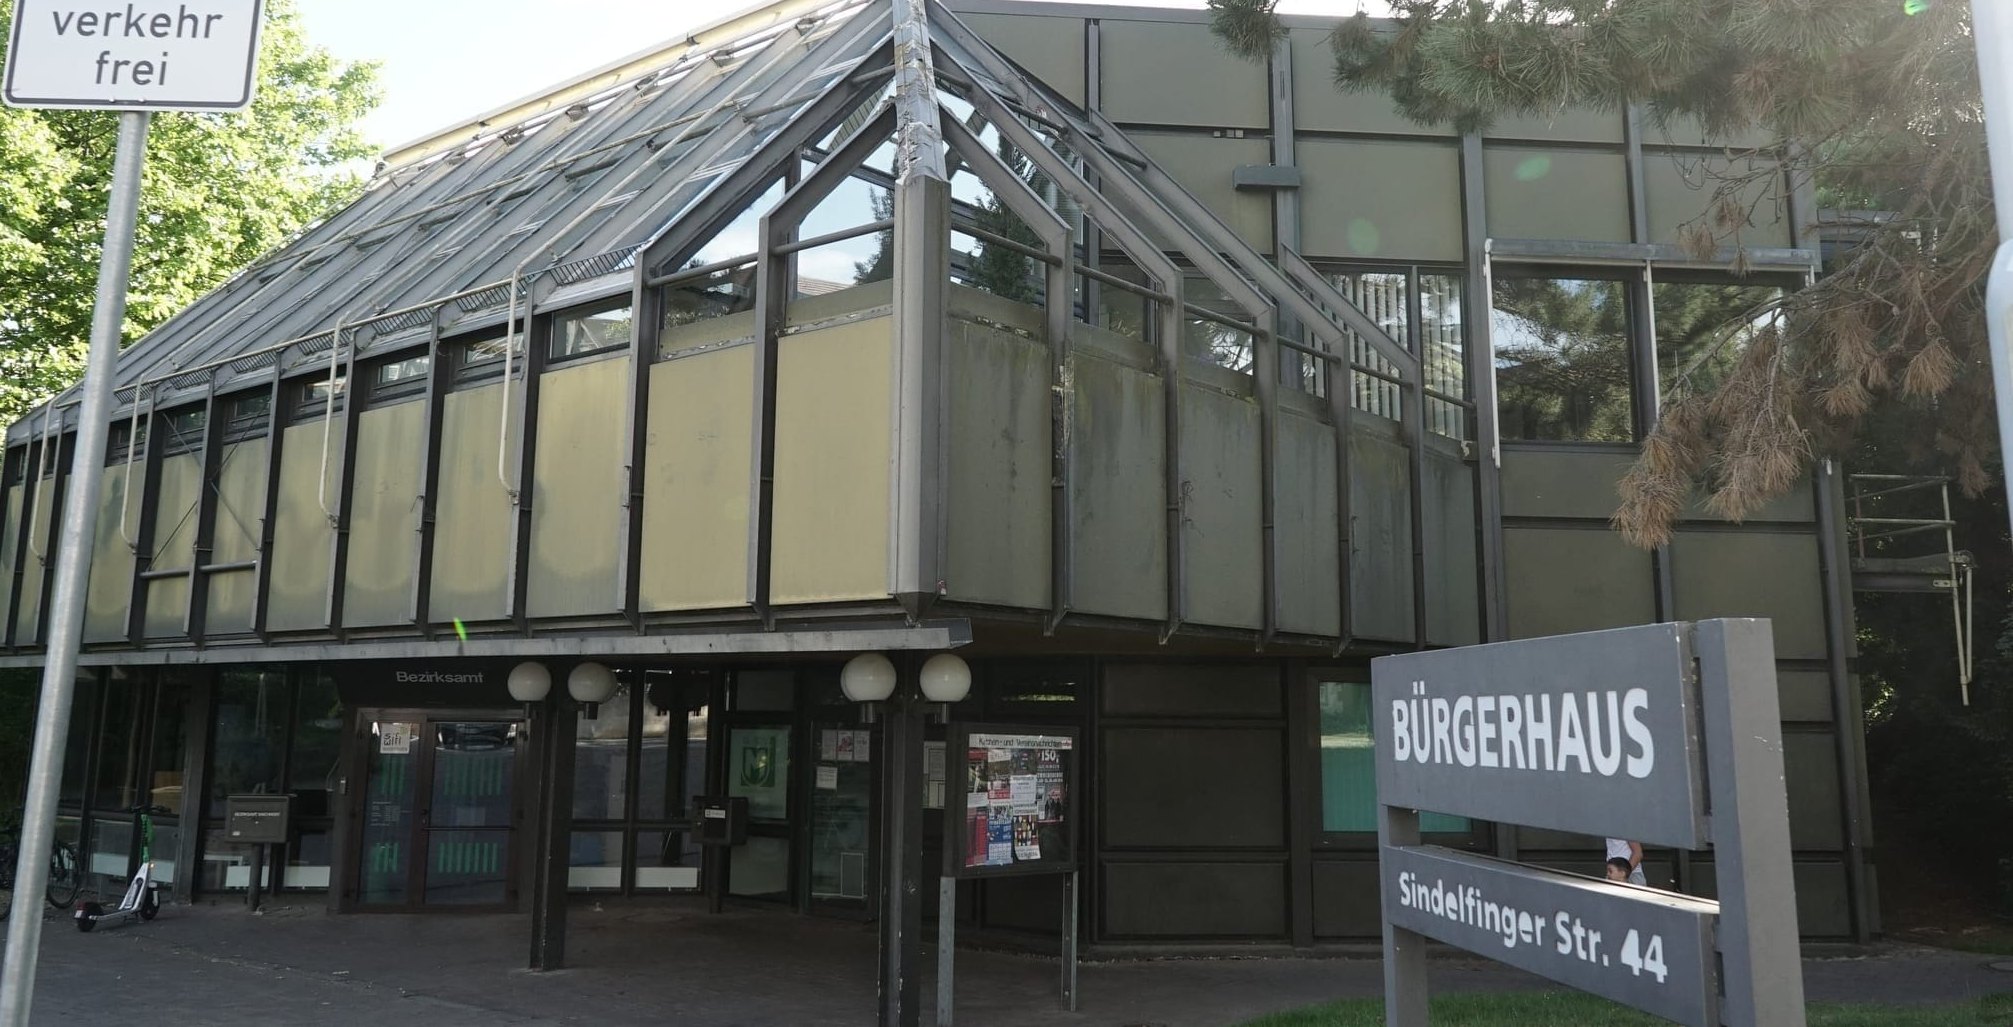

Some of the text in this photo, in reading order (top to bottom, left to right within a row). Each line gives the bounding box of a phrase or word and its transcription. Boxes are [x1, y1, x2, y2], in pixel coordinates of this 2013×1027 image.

[52, 3, 224, 39] verkehr
[95, 50, 169, 86] frei
[396, 671, 484, 683] Bezirksamt
[1391, 681, 1655, 779] BÜRGERHAUS
[1398, 871, 1668, 984] Sindelfinger Str. 44
